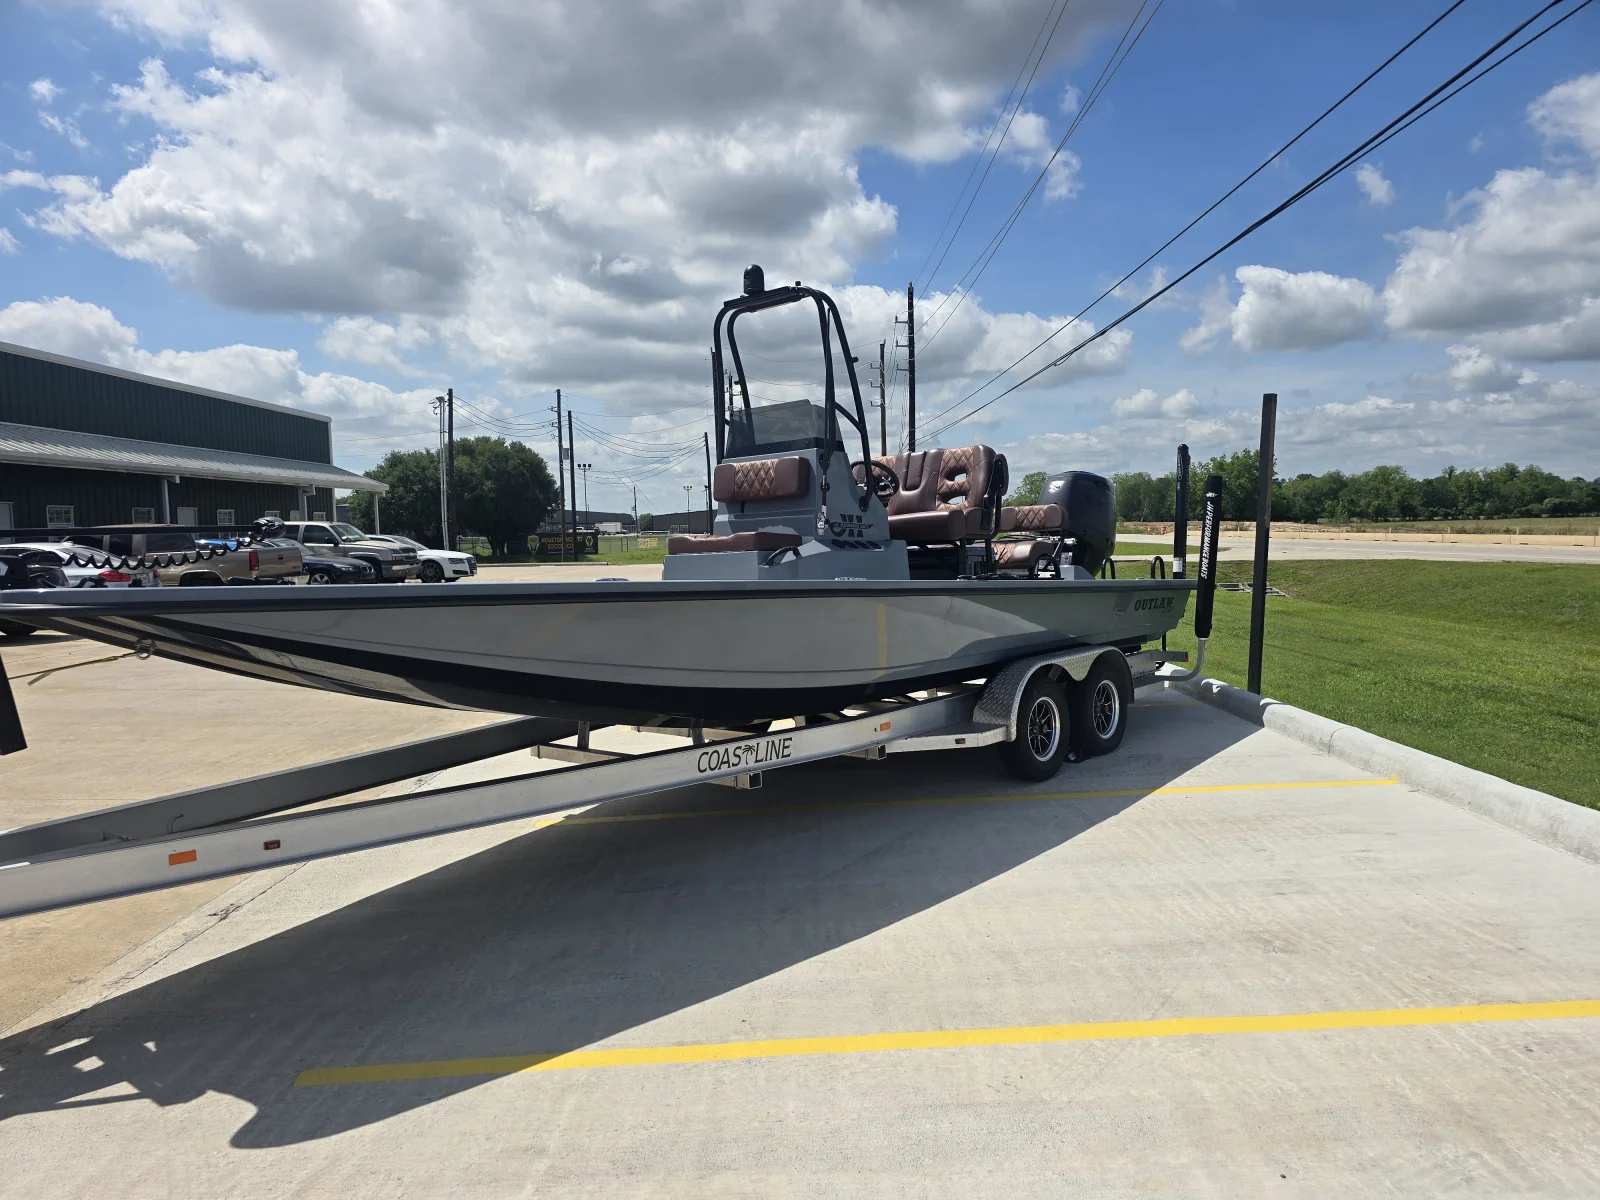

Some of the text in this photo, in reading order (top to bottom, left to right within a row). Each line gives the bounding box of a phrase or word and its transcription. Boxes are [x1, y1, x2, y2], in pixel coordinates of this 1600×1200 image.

[1200, 501, 1214, 579] JH PERFORMANCE BOATS
[1134, 596, 1175, 611] OUTLAW
